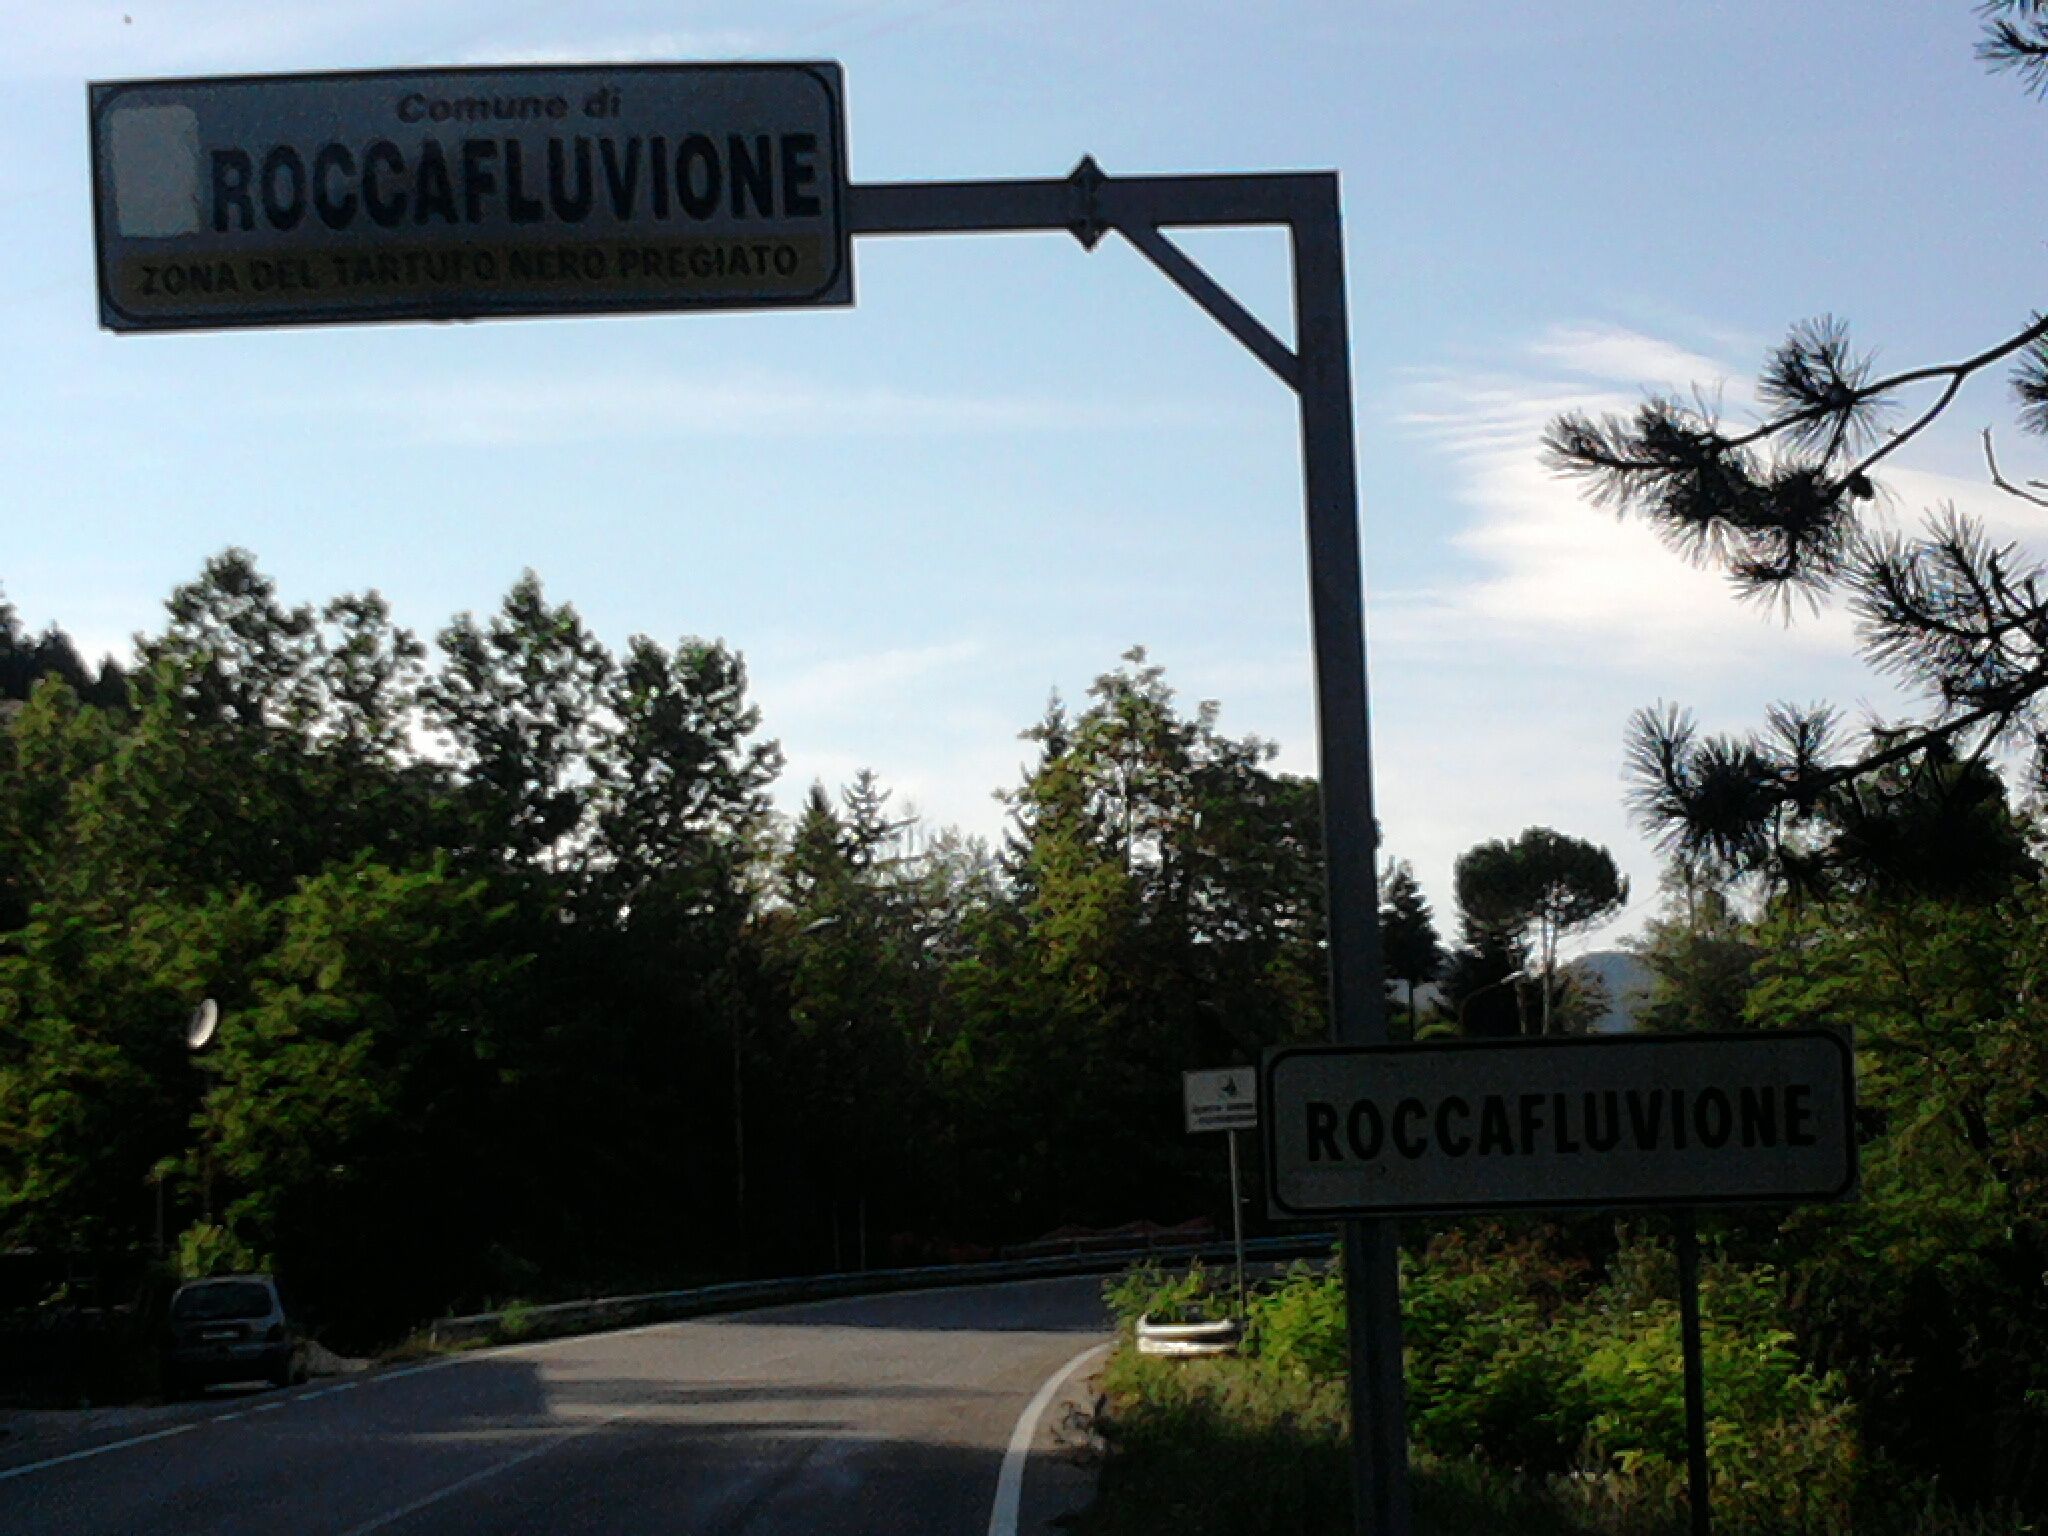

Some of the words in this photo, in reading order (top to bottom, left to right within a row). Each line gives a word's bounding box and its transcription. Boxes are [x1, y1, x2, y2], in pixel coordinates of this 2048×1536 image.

[398, 91, 569, 124] Comune
[584, 86, 622, 118] di
[211, 132, 822, 232] ROCCAFLUVIONE
[142, 260, 240, 298] ZONA
[250, 257, 317, 292] DEL
[331, 250, 496, 288] TARTUFO
[509, 247, 606, 282] NERO
[620, 243, 797, 280] PREGIATO
[1306, 1084, 1816, 1162] ROCCAFLUVIONE
